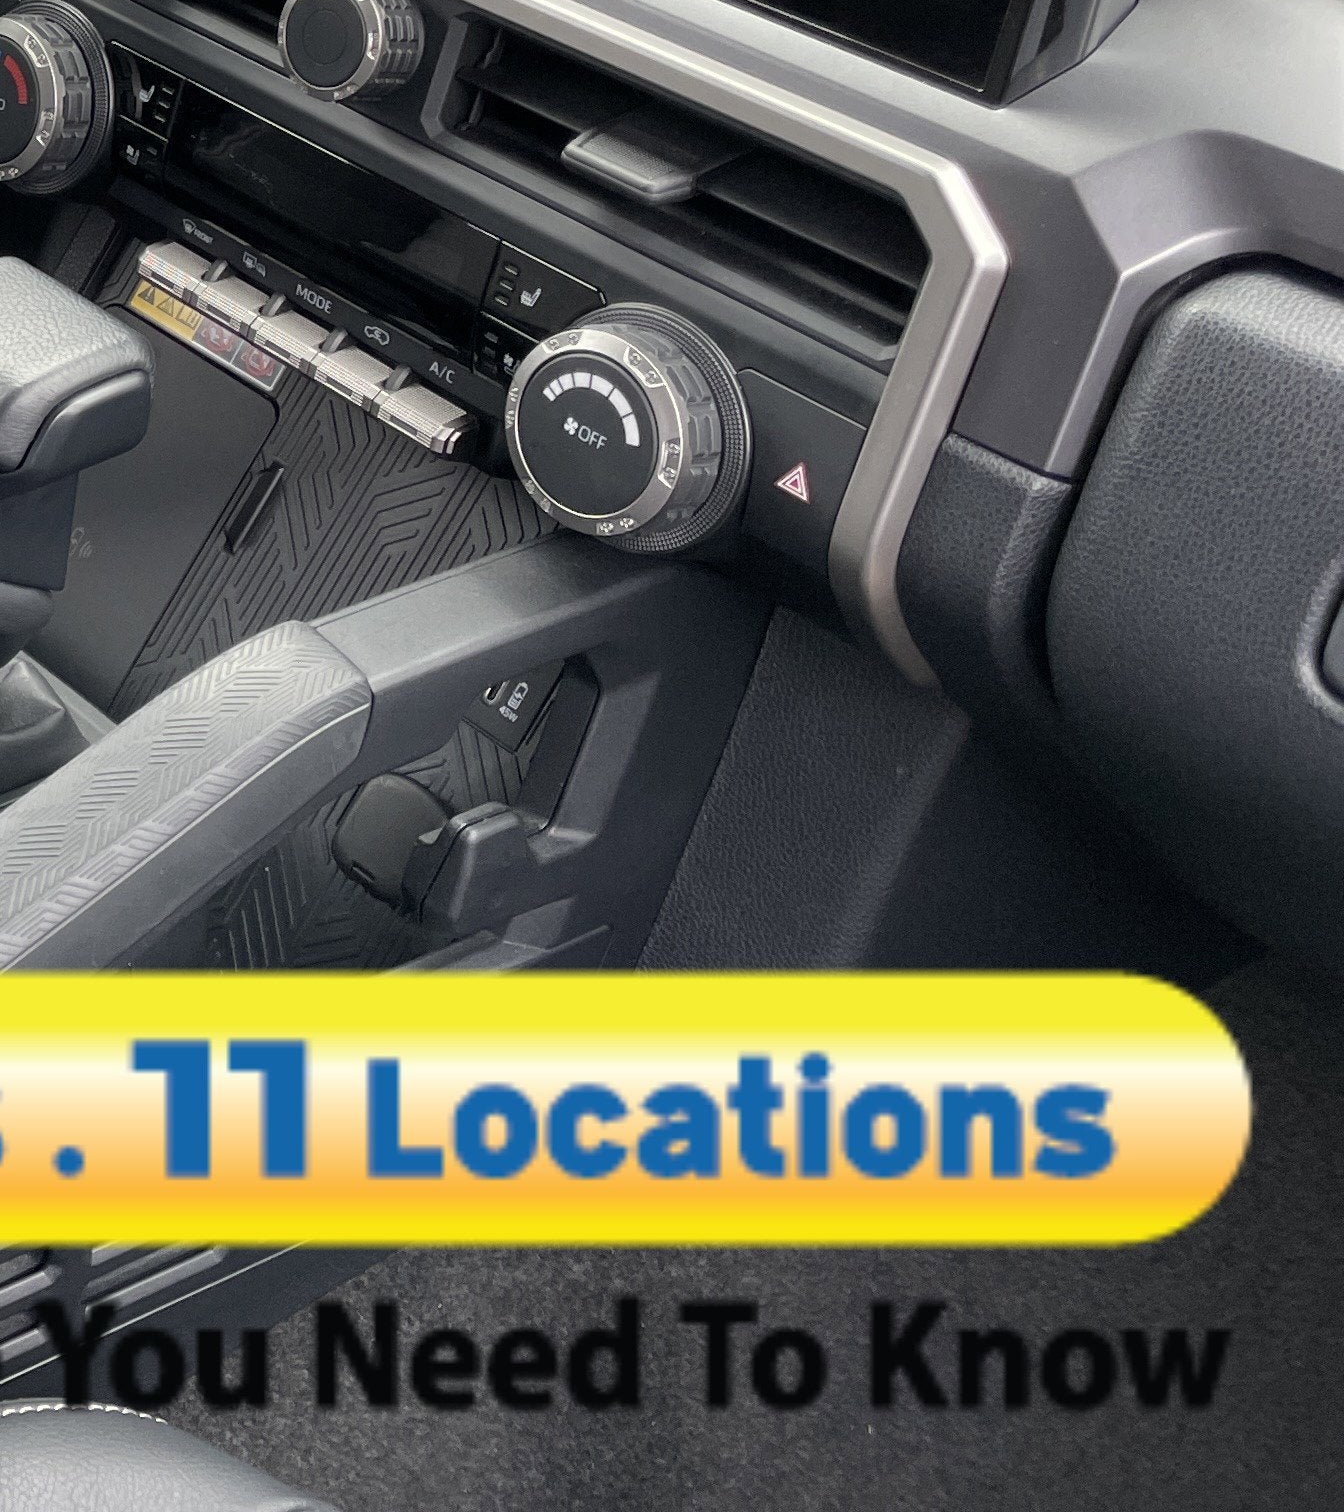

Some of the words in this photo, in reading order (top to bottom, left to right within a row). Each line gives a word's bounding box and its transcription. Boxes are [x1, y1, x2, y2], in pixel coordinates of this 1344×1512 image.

[295, 284, 333, 314] MODE
[428, 361, 456, 384] A/C
[578, 425, 608, 449] OFF
